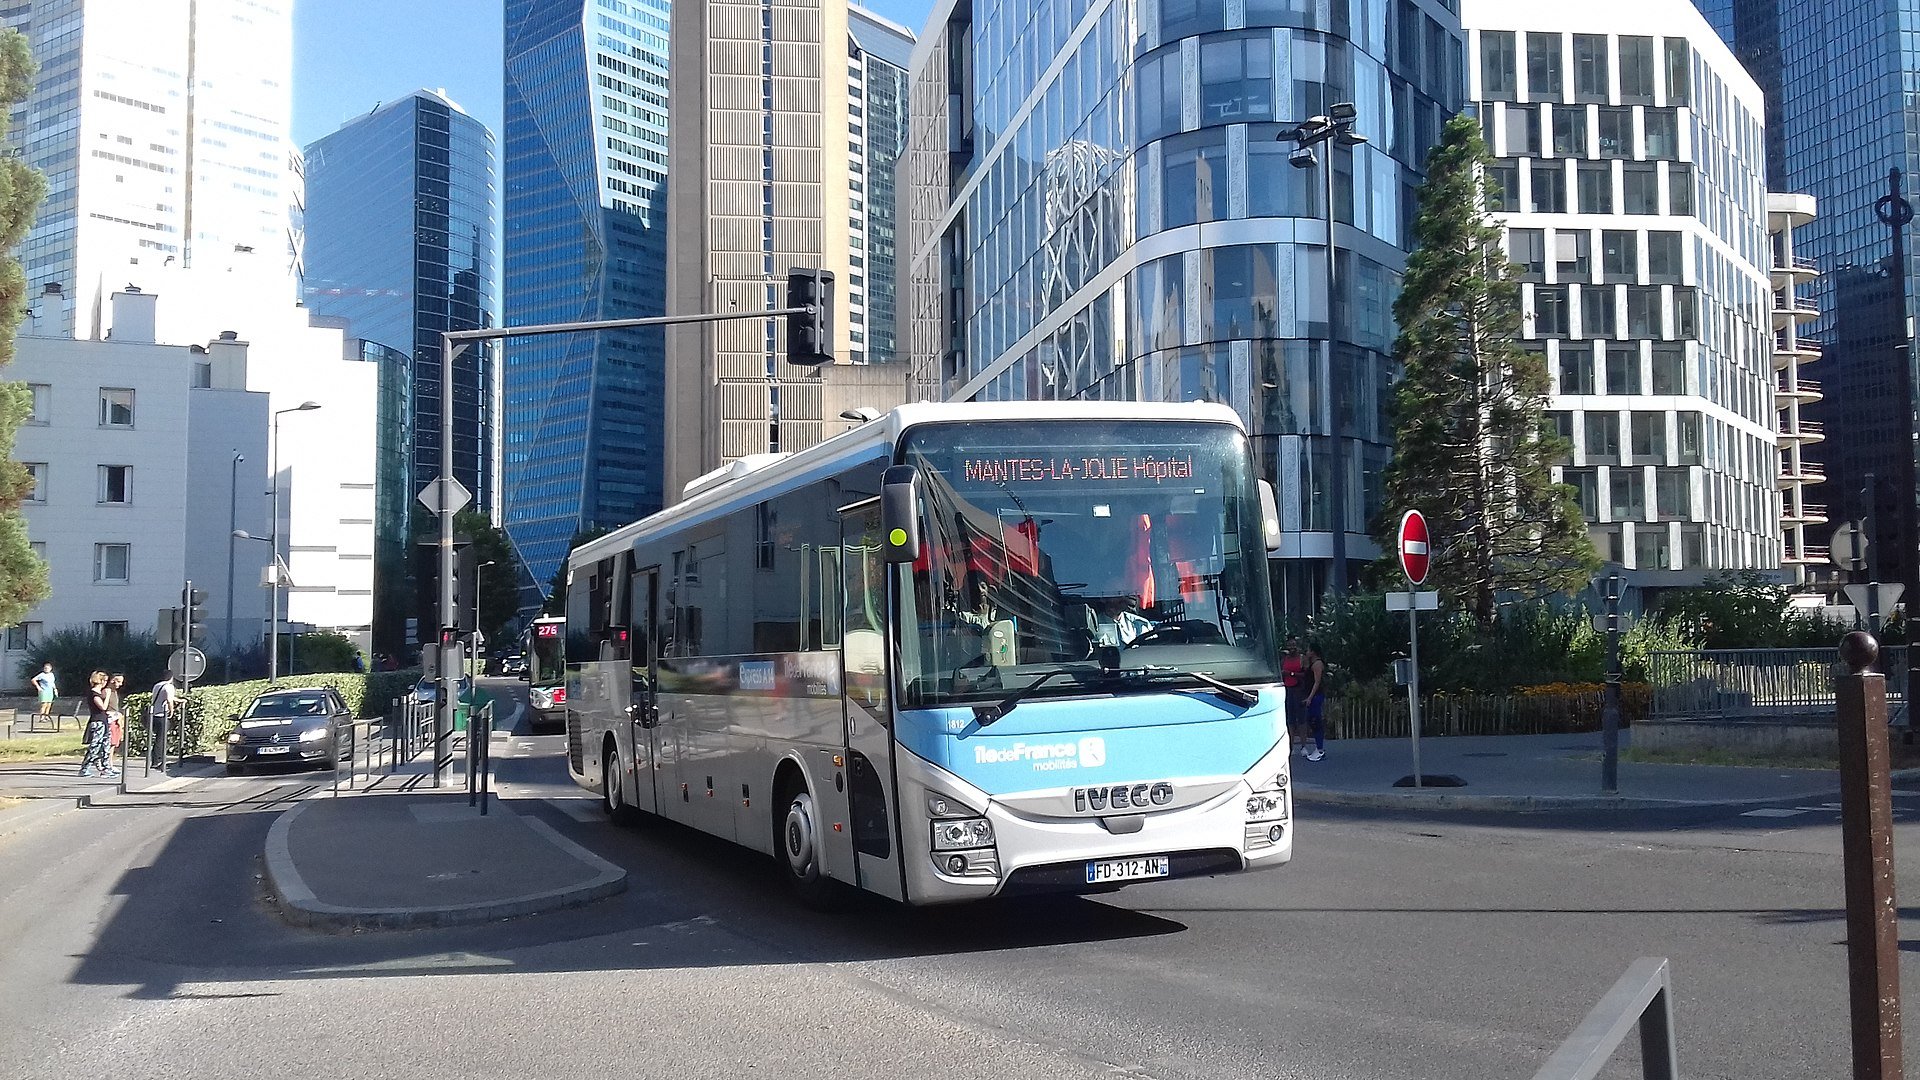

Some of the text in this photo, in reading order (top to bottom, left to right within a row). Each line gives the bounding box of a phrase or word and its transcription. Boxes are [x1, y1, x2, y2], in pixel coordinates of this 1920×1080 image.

[964, 454, 1193, 484] MANTES-LA-JOLIE Hôpital
[538, 625, 557, 636] 276
[948, 719, 965, 729] 1812
[1074, 782, 1174, 812] IVECO
[1096, 859, 1159, 880] FD-312-AN
